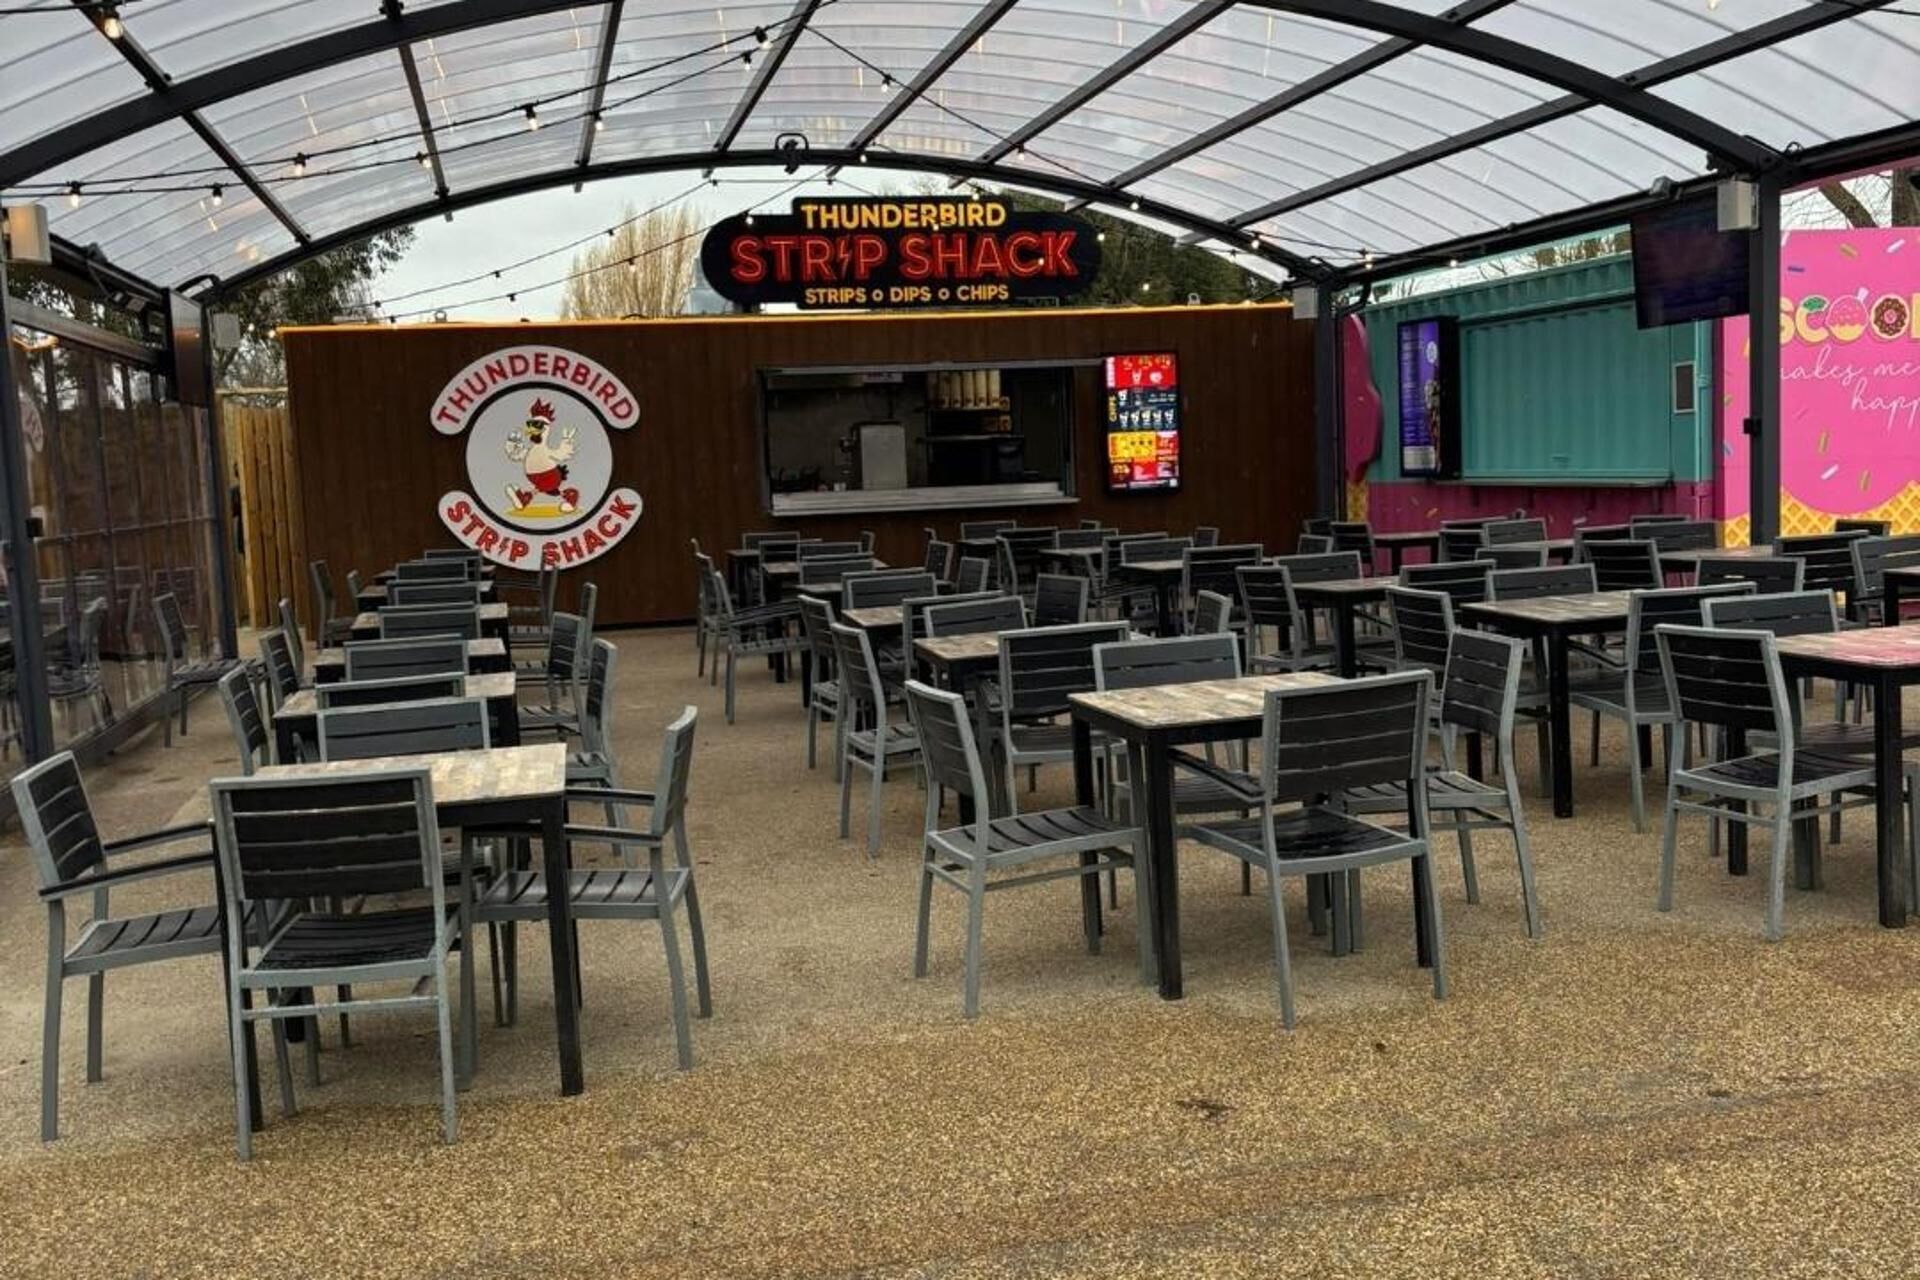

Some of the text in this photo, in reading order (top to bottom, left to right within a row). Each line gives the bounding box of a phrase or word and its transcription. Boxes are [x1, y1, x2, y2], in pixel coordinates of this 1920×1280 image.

[801, 202, 1006, 230] THUNDERBIRD
[731, 230, 1079, 283] STRIP SHACK
[805, 284, 1009, 305] STRIPS DIPS CHIPS
[437, 352, 634, 426] THUNDERBIRD
[1780, 346, 1863, 387] akes
[447, 495, 637, 566] STRIP SHACK
